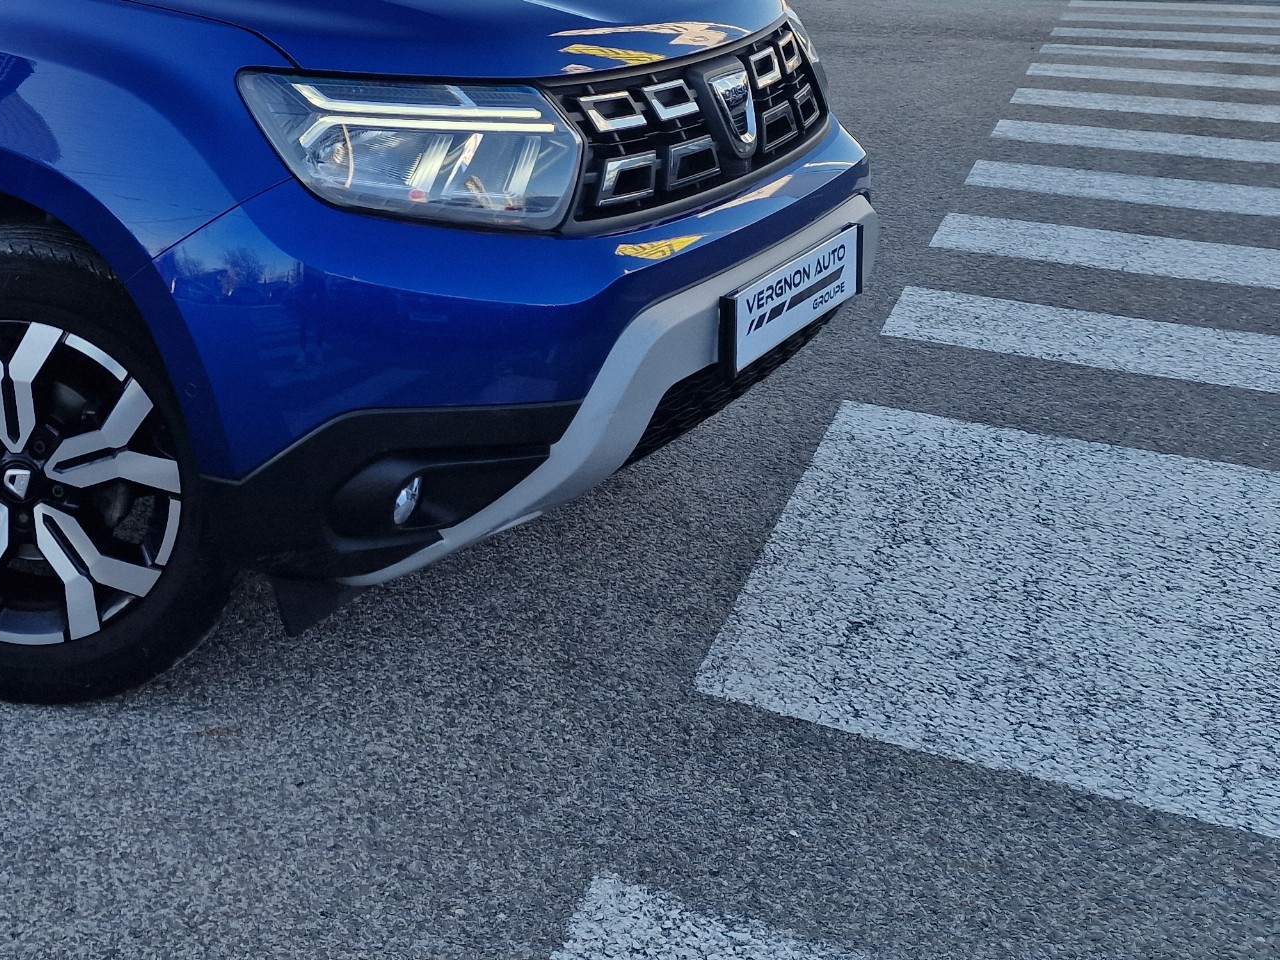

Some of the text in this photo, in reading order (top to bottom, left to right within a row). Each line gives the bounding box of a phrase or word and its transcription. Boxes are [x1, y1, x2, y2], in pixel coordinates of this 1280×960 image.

[746, 244, 846, 315] VERGNON AUTO
[812, 280, 846, 310] GROUPE
